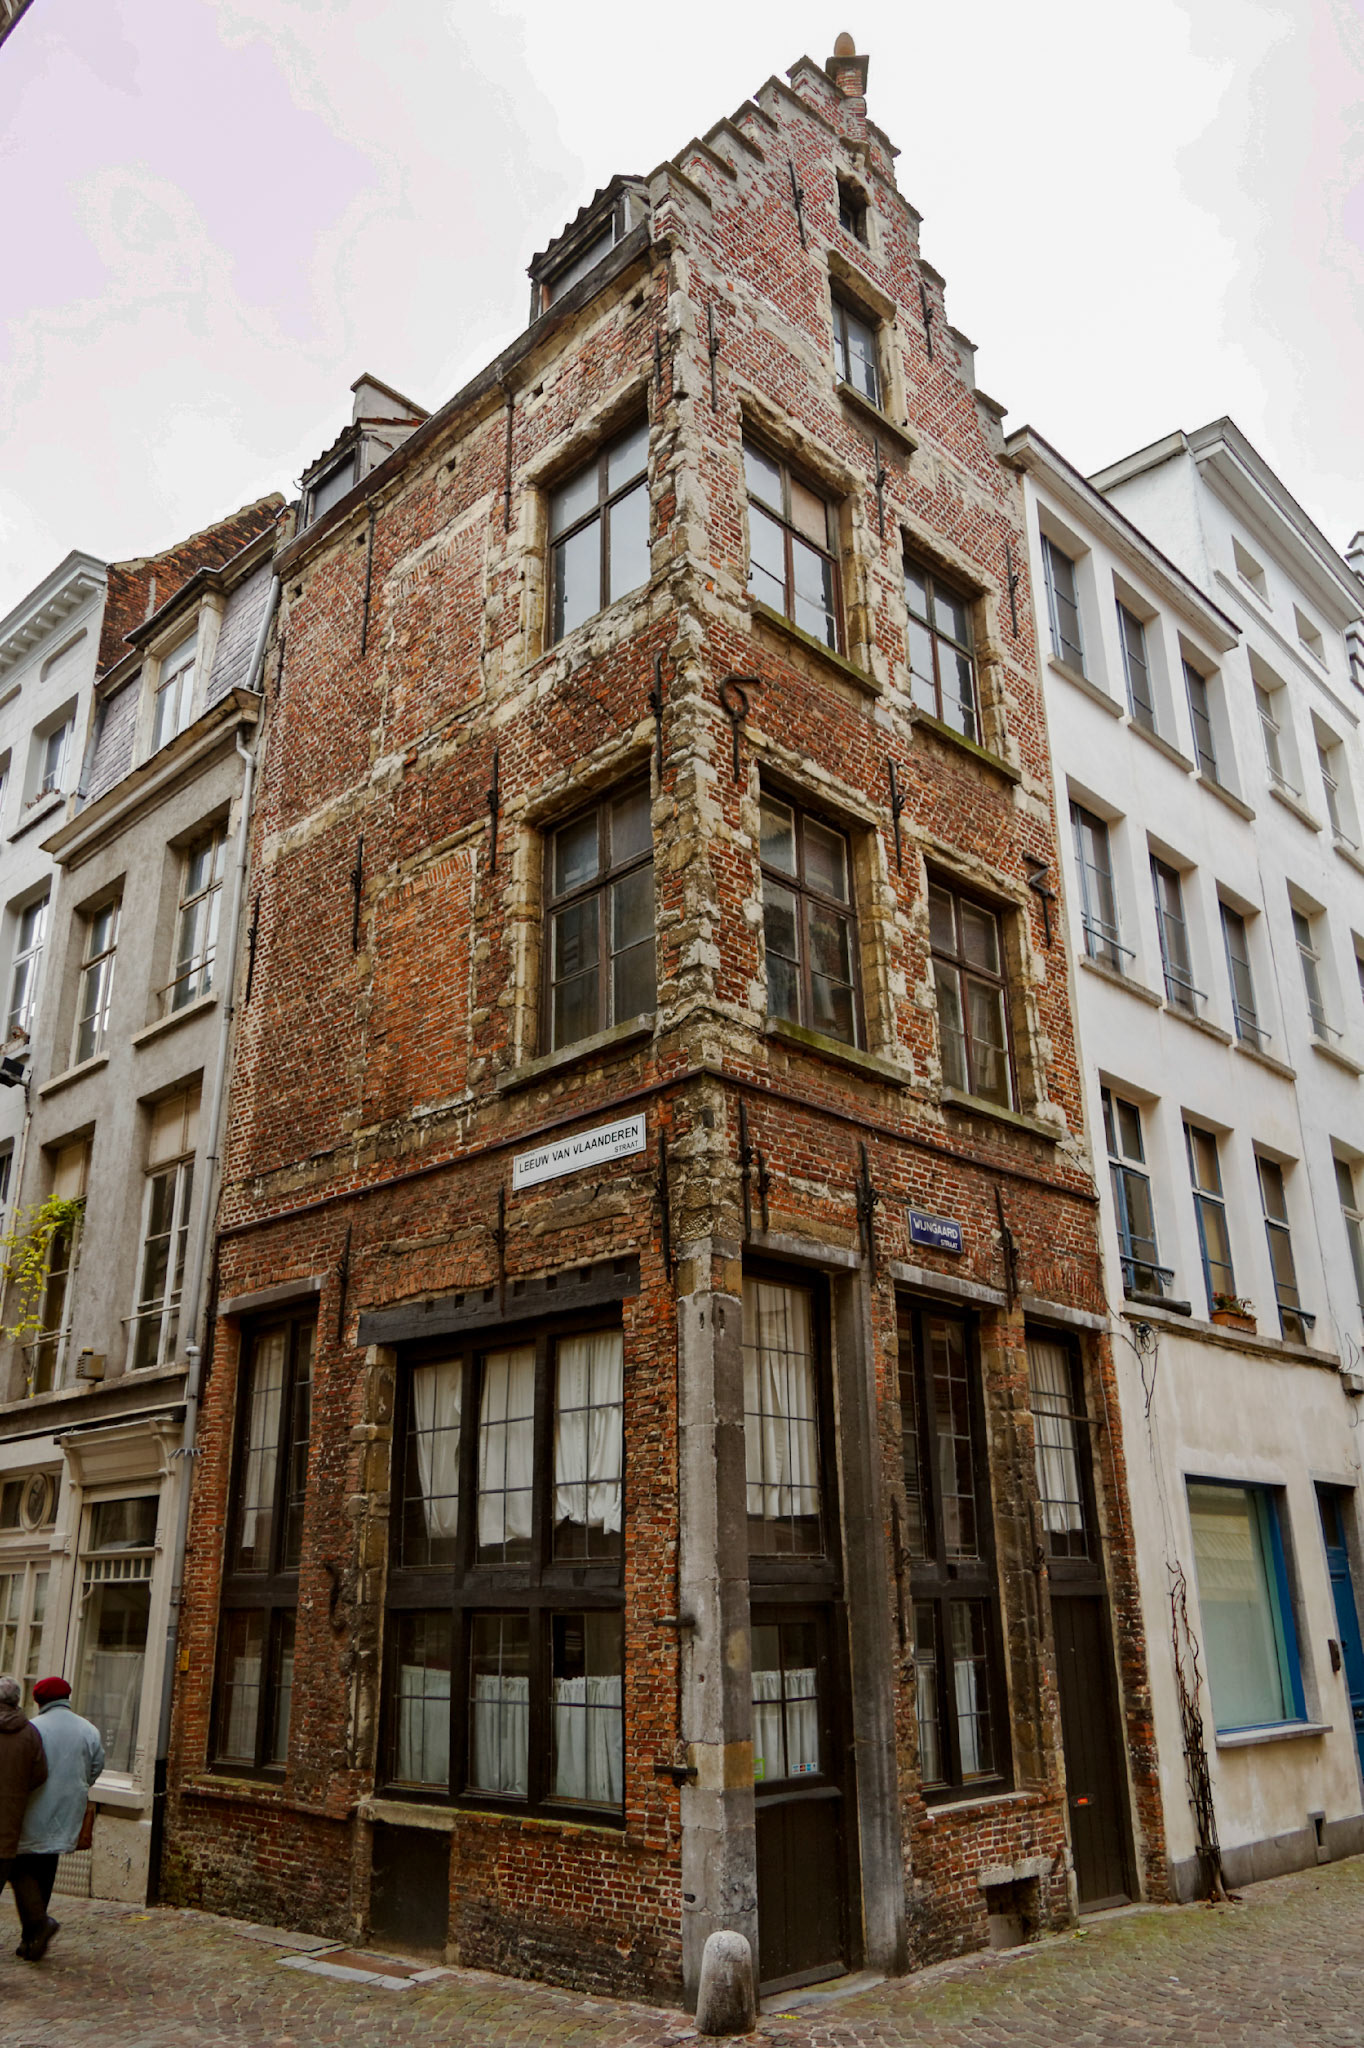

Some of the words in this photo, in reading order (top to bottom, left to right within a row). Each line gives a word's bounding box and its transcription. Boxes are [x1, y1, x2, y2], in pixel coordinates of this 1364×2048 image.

[519, 1154, 549, 1173] LEEUW
[552, 1147, 570, 1161] VAN
[573, 1125, 638, 1155] VLAANDEREN
[614, 1140, 638, 1153] STRAAT
[913, 1217, 958, 1239] WIJNGAARD
